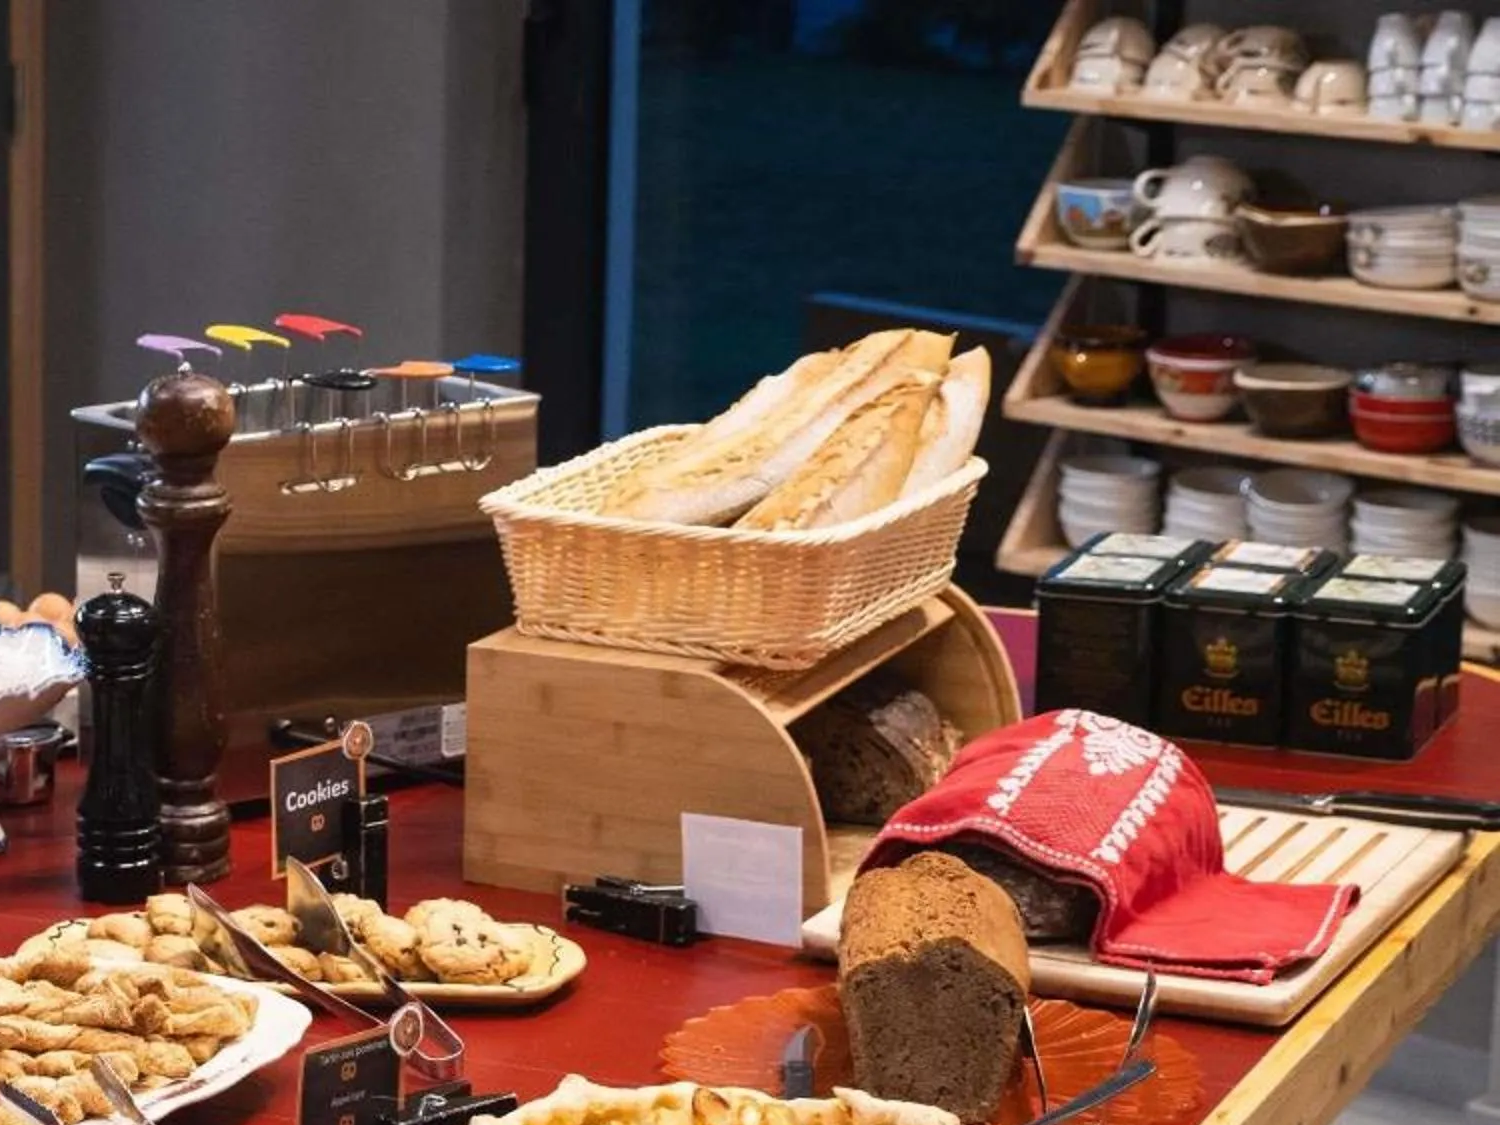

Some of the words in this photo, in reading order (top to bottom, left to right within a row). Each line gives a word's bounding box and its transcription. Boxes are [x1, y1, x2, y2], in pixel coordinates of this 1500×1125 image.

[1181, 686, 1259, 716] Eilles
[1309, 698, 1392, 730] Eilles
[285, 778, 350, 812] Cookies
